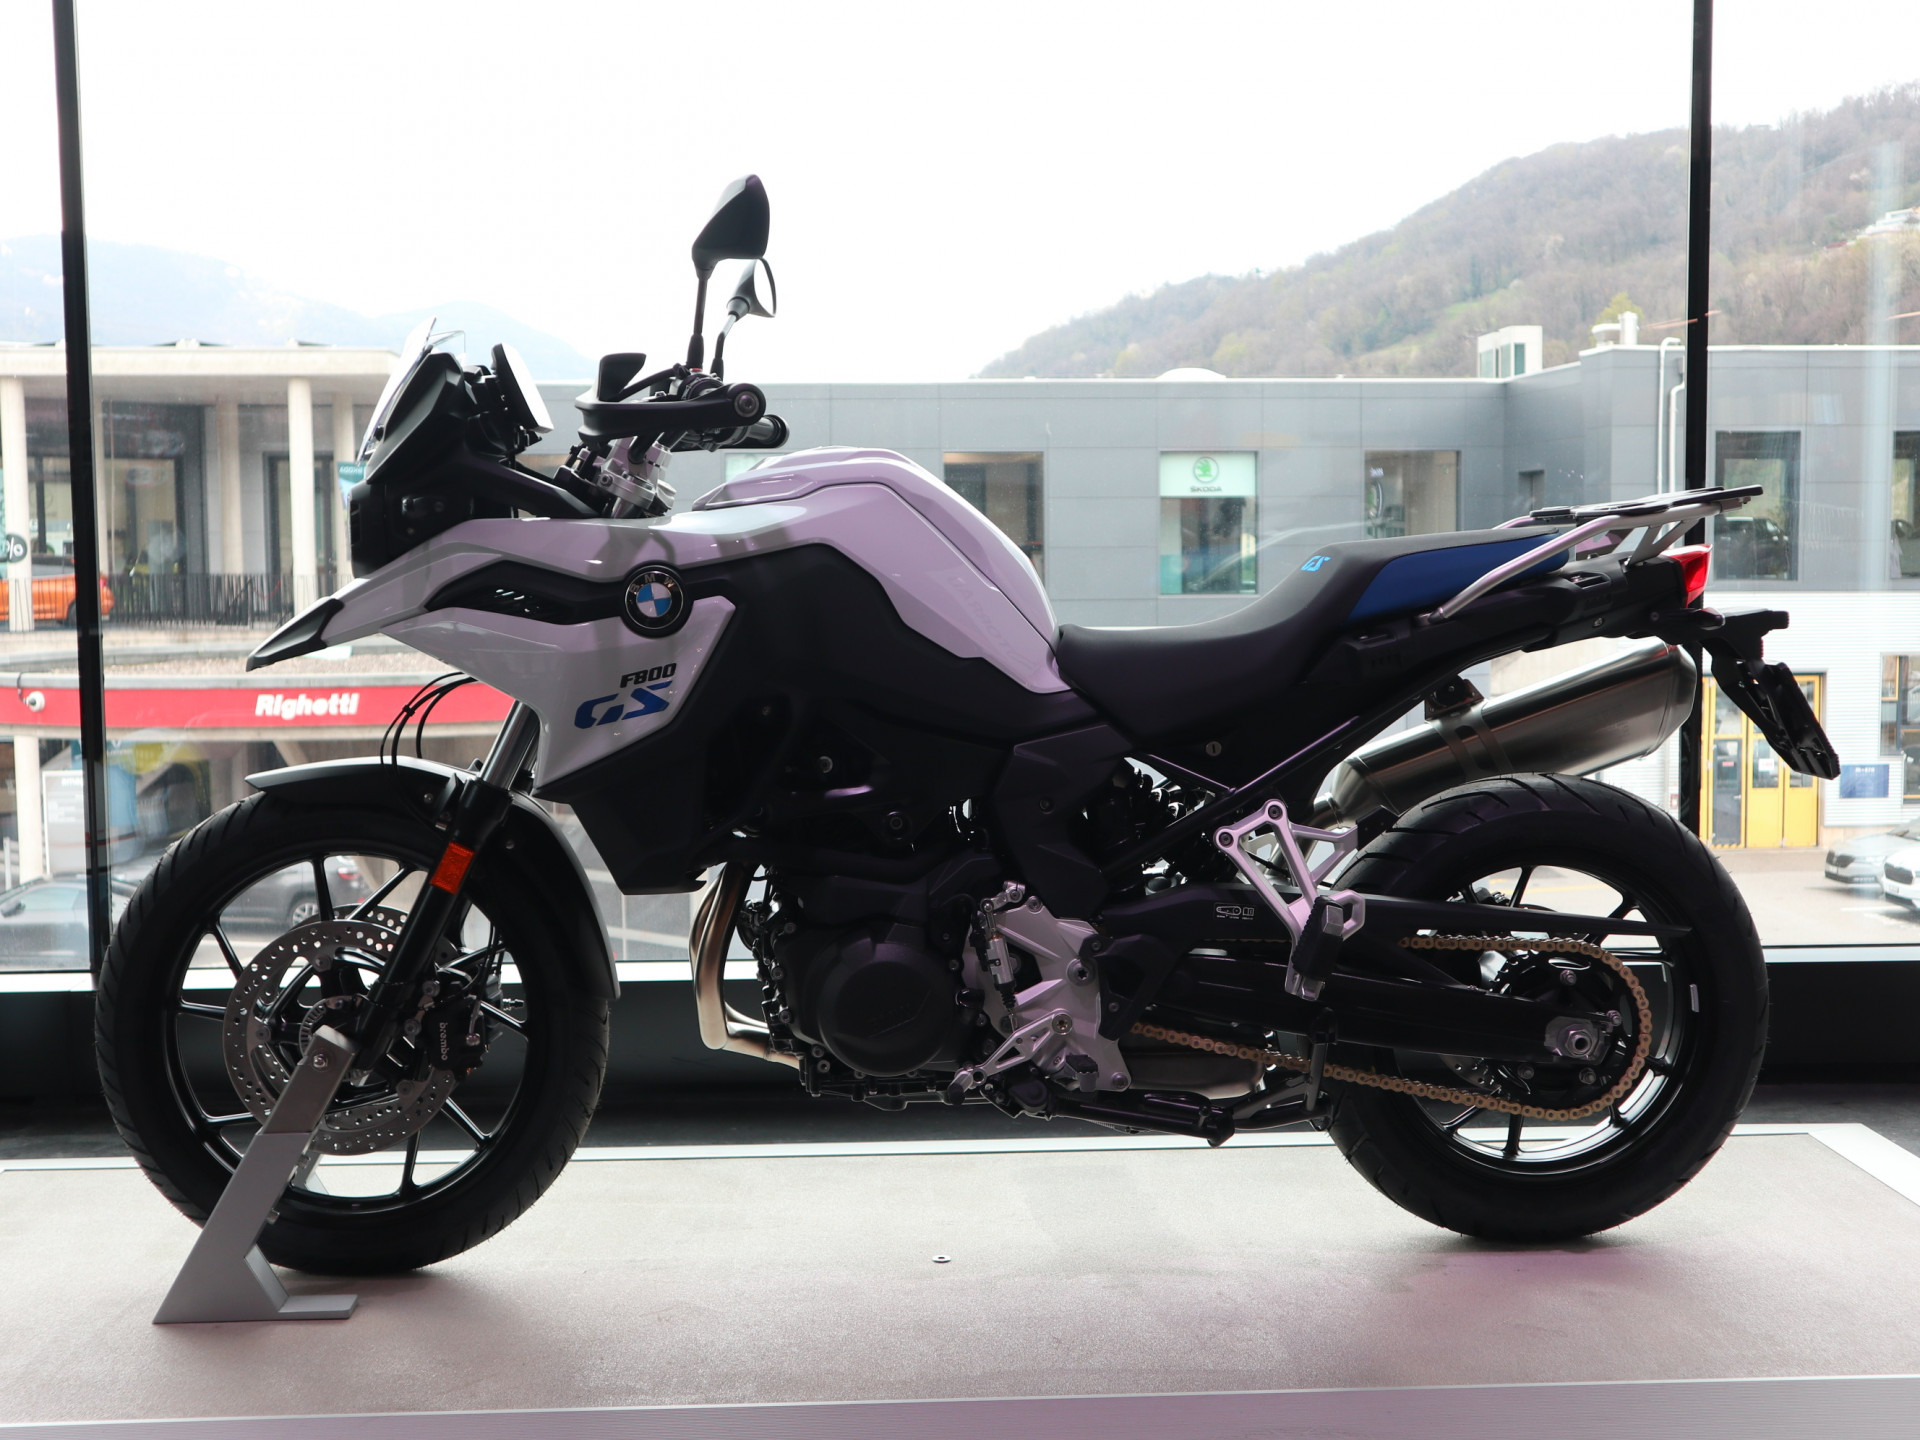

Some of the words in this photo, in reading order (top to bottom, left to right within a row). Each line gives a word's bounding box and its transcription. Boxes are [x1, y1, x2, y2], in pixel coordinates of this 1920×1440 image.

[629, 573, 675, 595] BMW
[619, 662, 677, 689] F800
[254, 693, 360, 720] Righetti
[574, 680, 673, 729] GS
[439, 1022, 449, 1061] brembo
